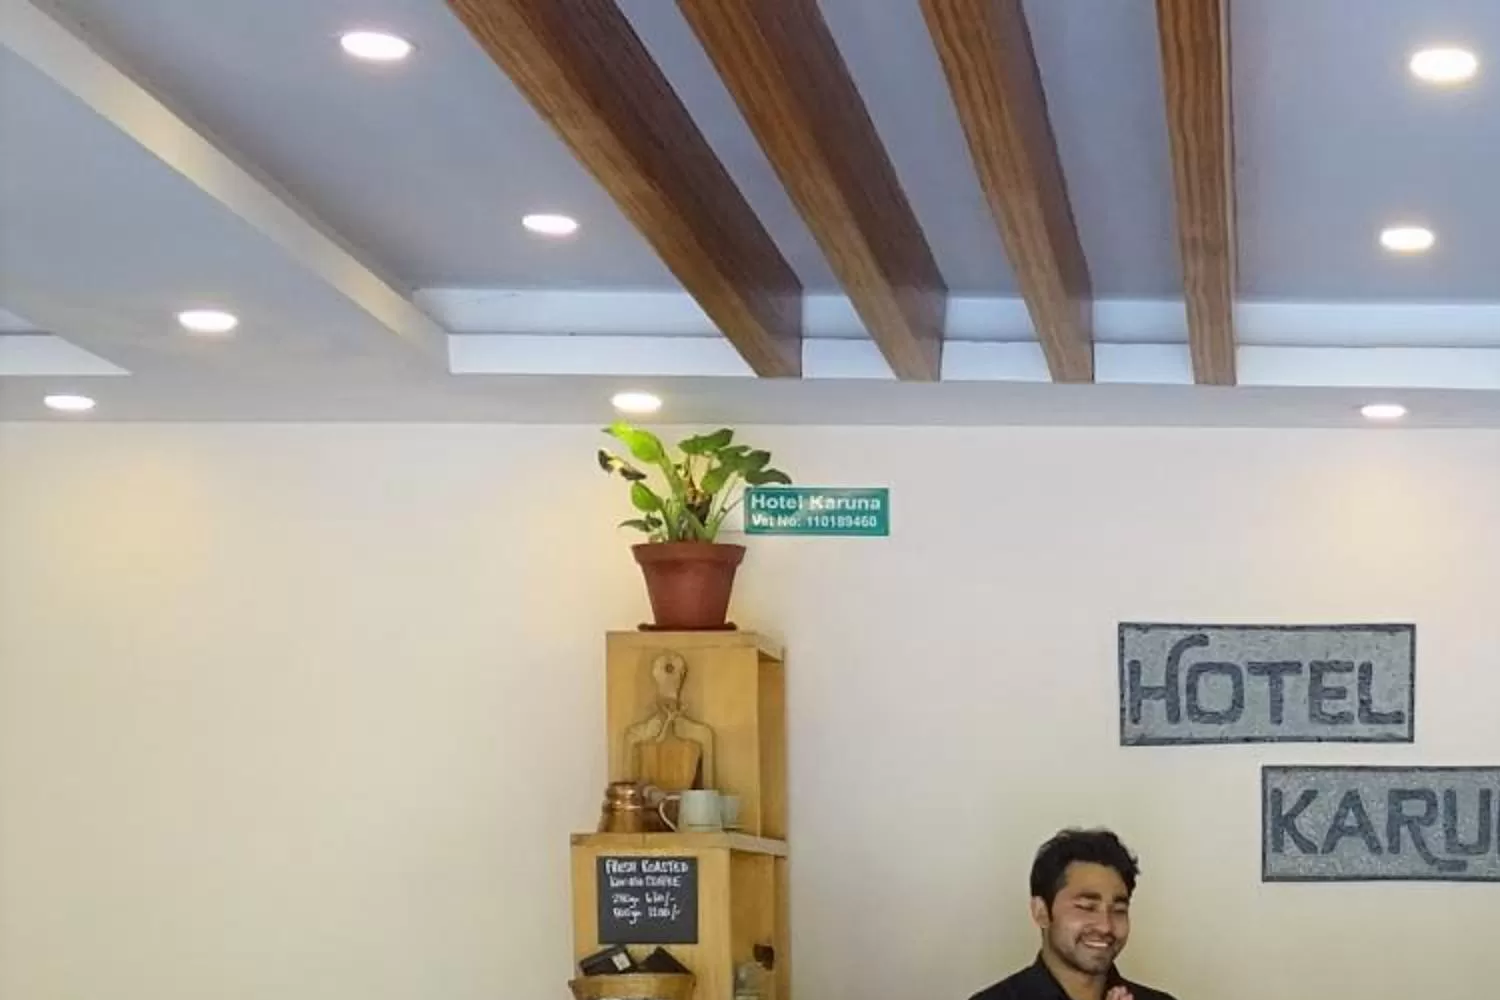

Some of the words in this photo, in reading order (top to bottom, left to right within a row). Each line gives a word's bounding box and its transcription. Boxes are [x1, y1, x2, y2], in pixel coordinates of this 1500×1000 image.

[751, 494, 803, 509] Hotel
[809, 495, 881, 510] Karuna
[1127, 633, 1405, 725] HOTEL
